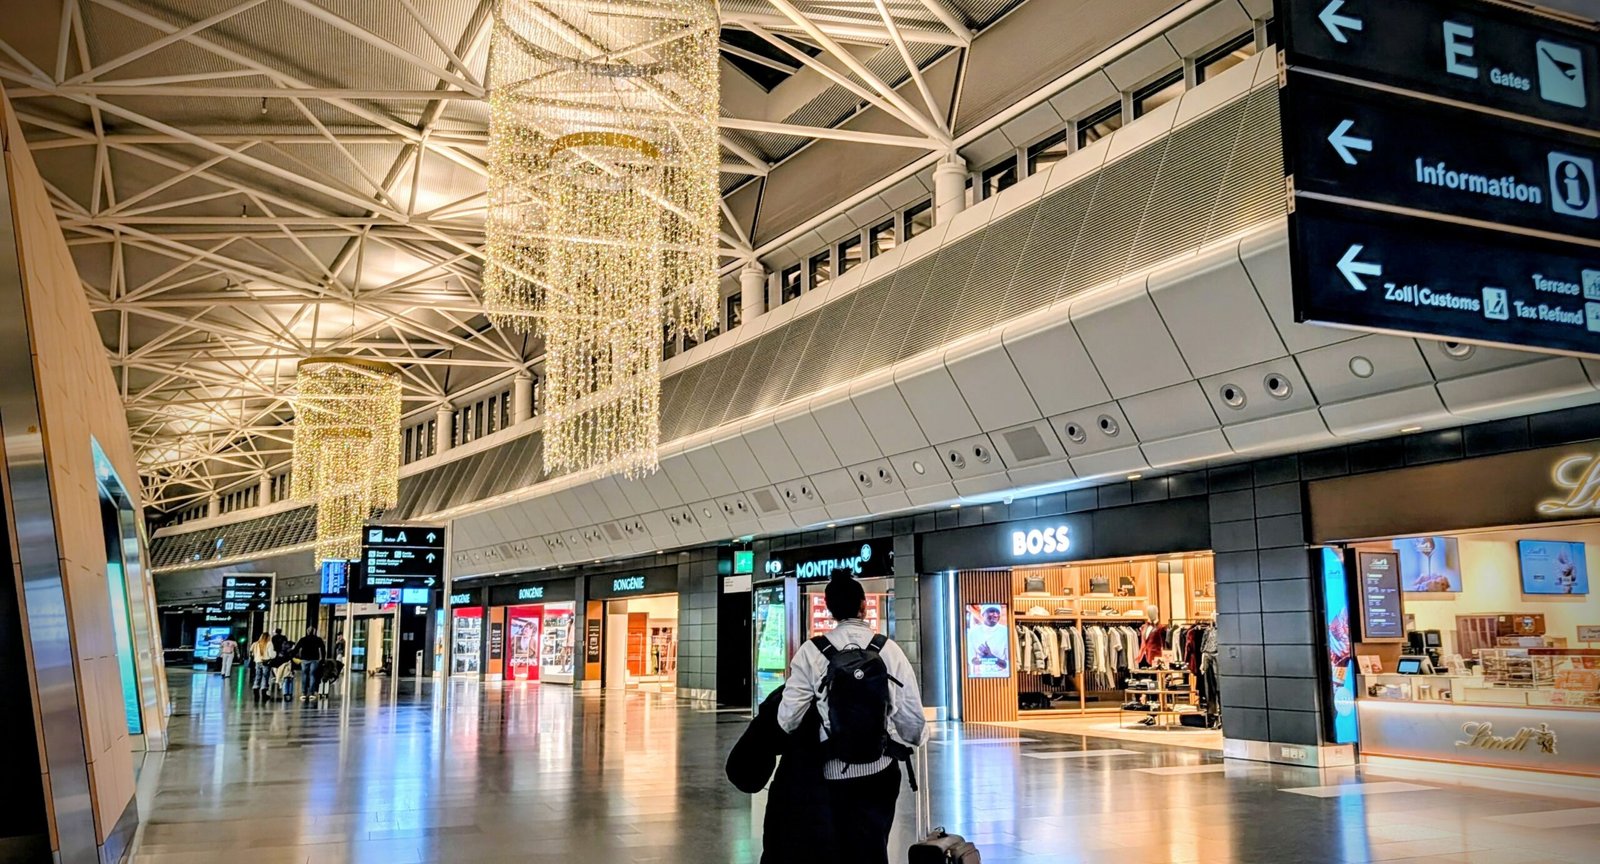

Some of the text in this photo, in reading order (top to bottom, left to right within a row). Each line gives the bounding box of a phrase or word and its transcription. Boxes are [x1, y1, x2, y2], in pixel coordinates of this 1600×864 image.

[1443, 21, 1530, 91] E Gates
[1415, 157, 1542, 204] Information
[1532, 273, 1580, 296] Terrace
[1513, 301, 1584, 325] Tax Refund
[396, 531, 407, 543] A
[1012, 525, 1070, 556] BOSS
[613, 576, 645, 592] BONGÉNIE
[1455, 722, 1536, 751] Lindt
